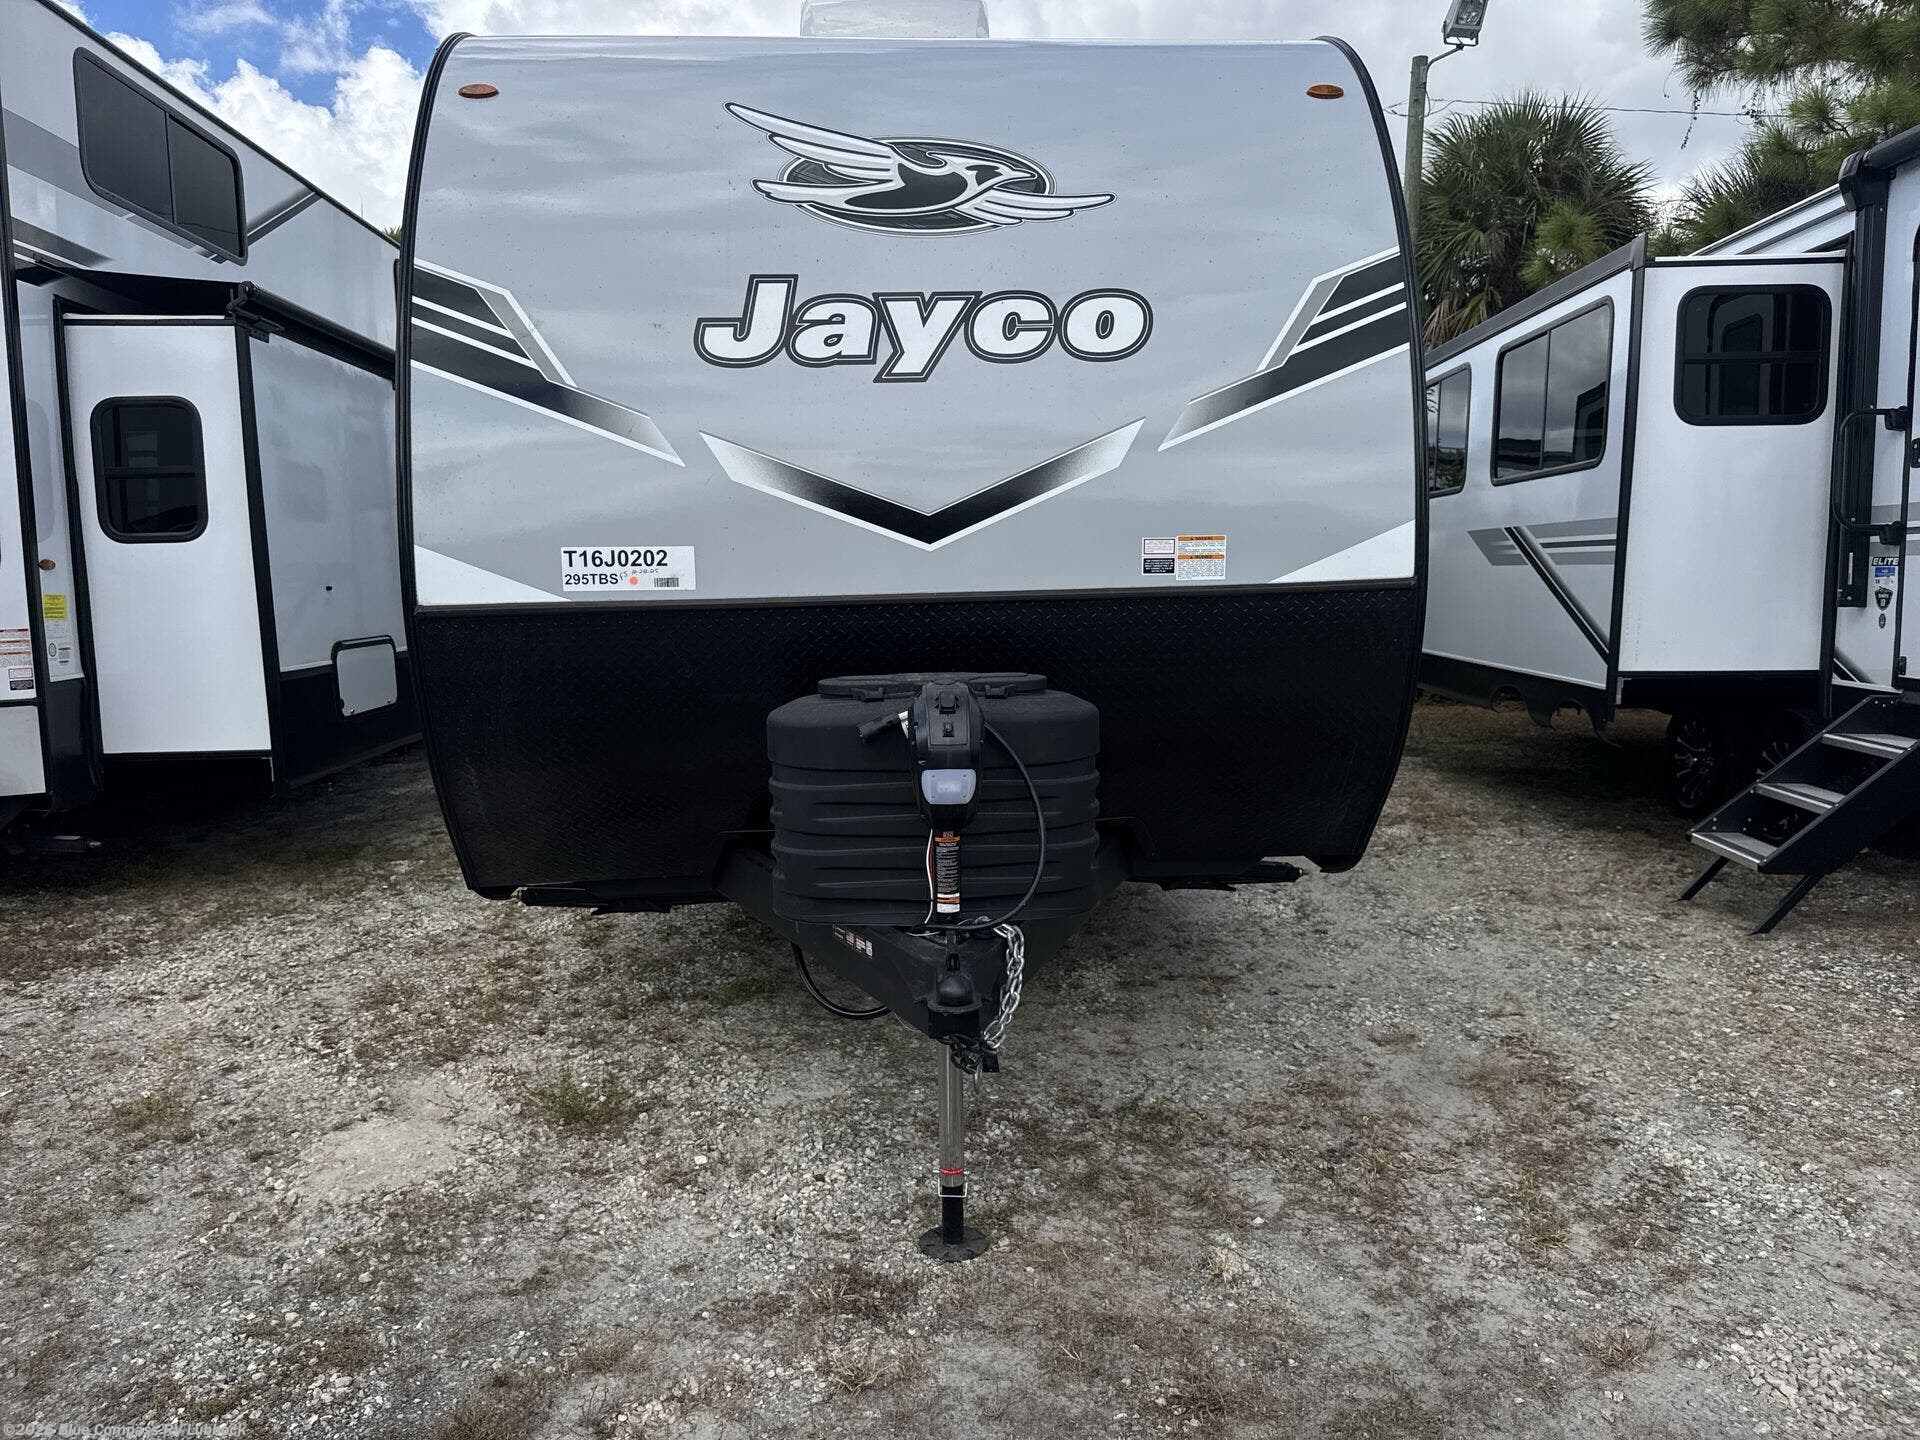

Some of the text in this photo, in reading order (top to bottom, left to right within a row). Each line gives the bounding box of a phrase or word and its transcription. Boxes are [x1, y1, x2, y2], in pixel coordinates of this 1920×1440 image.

[693, 274, 1154, 383] Jayco
[563, 549, 668, 567] T16J0202
[1872, 557, 1899, 566] ELITE
[564, 573, 619, 585] 295TBS
